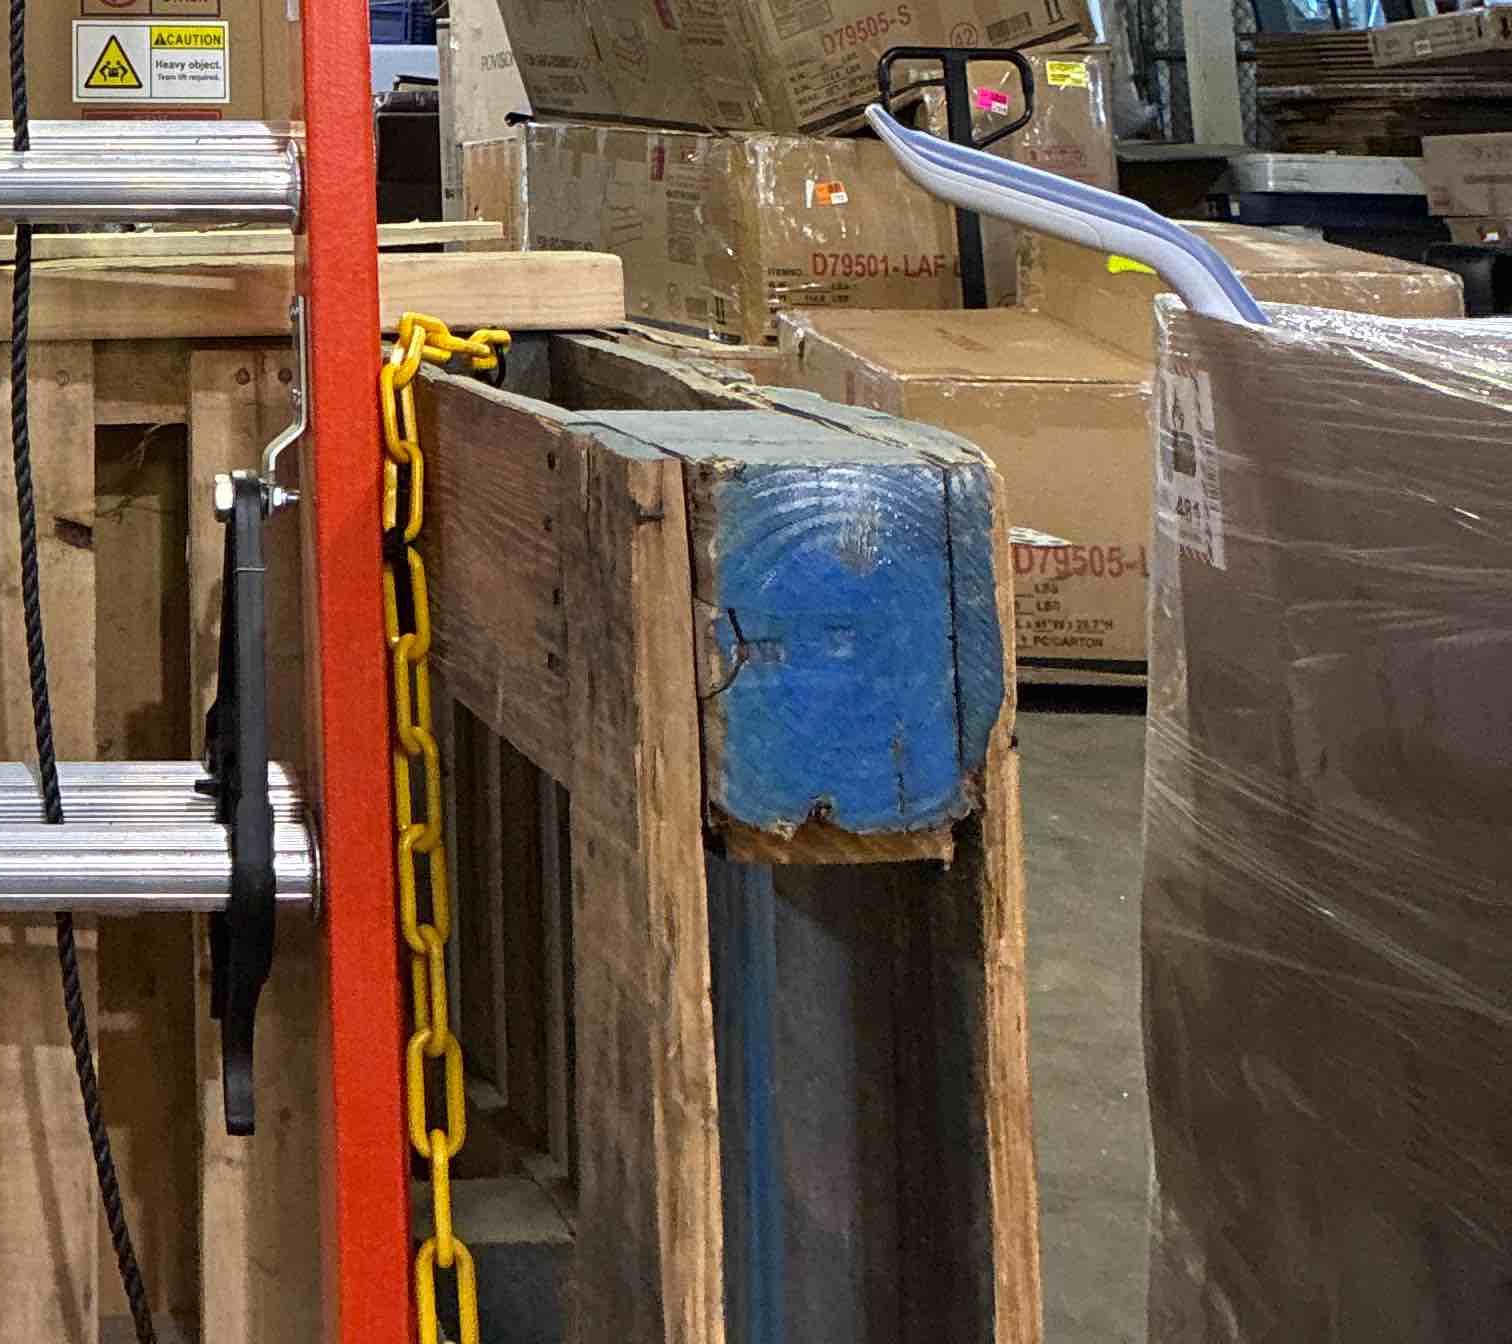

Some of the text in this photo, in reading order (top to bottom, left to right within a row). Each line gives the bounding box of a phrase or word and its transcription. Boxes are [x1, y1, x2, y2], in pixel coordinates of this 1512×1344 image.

[166, 33, 221, 47] CAUTION
[155, 59, 222, 72] Heavy object.
[812, 253, 945, 279] D79501-LAF
